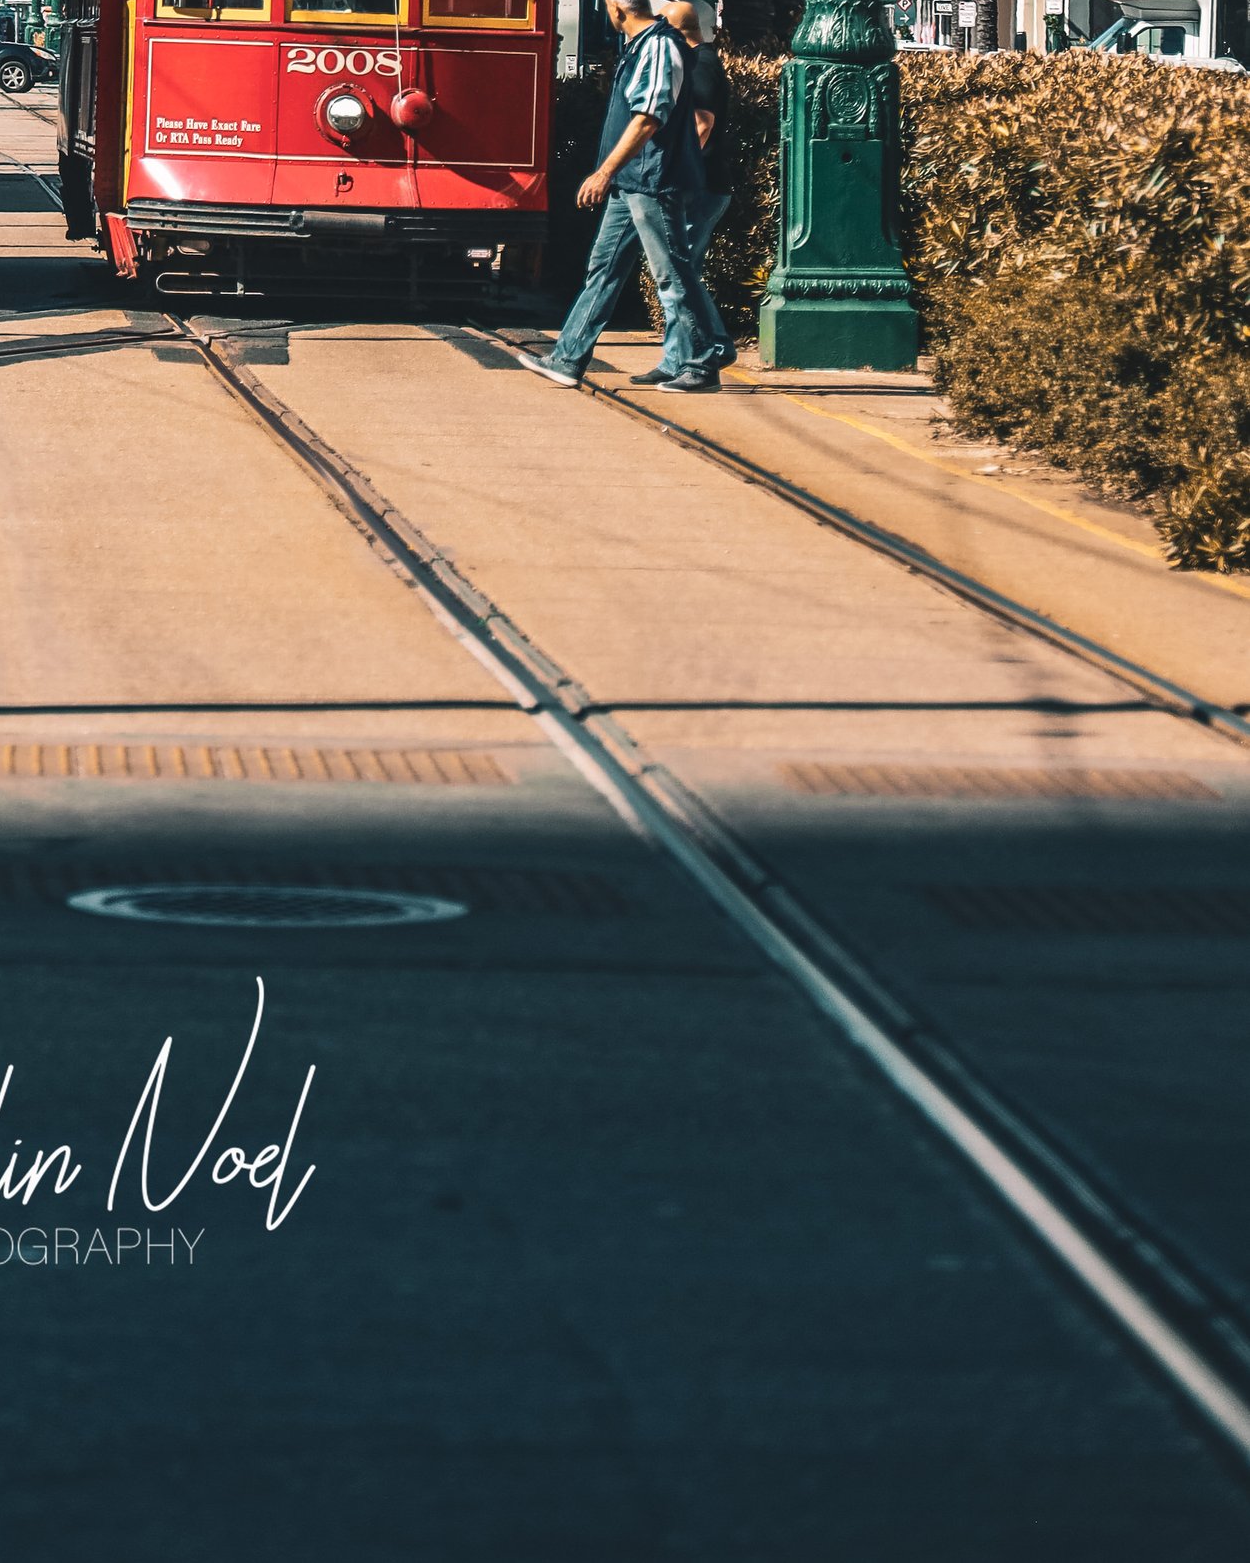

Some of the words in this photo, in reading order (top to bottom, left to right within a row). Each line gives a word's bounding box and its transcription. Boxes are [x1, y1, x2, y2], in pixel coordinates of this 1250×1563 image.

[287, 48, 403, 76] 2008
[156, 117, 183, 129] Please
[186, 119, 208, 130] Have
[211, 119, 237, 131] Exact
[240, 120, 261, 132] Fare
[156, 132, 168, 143] Or
[170, 133, 189, 144] RTA
[192, 133, 212, 145] Pass
[215, 135, 243, 147] Ready
